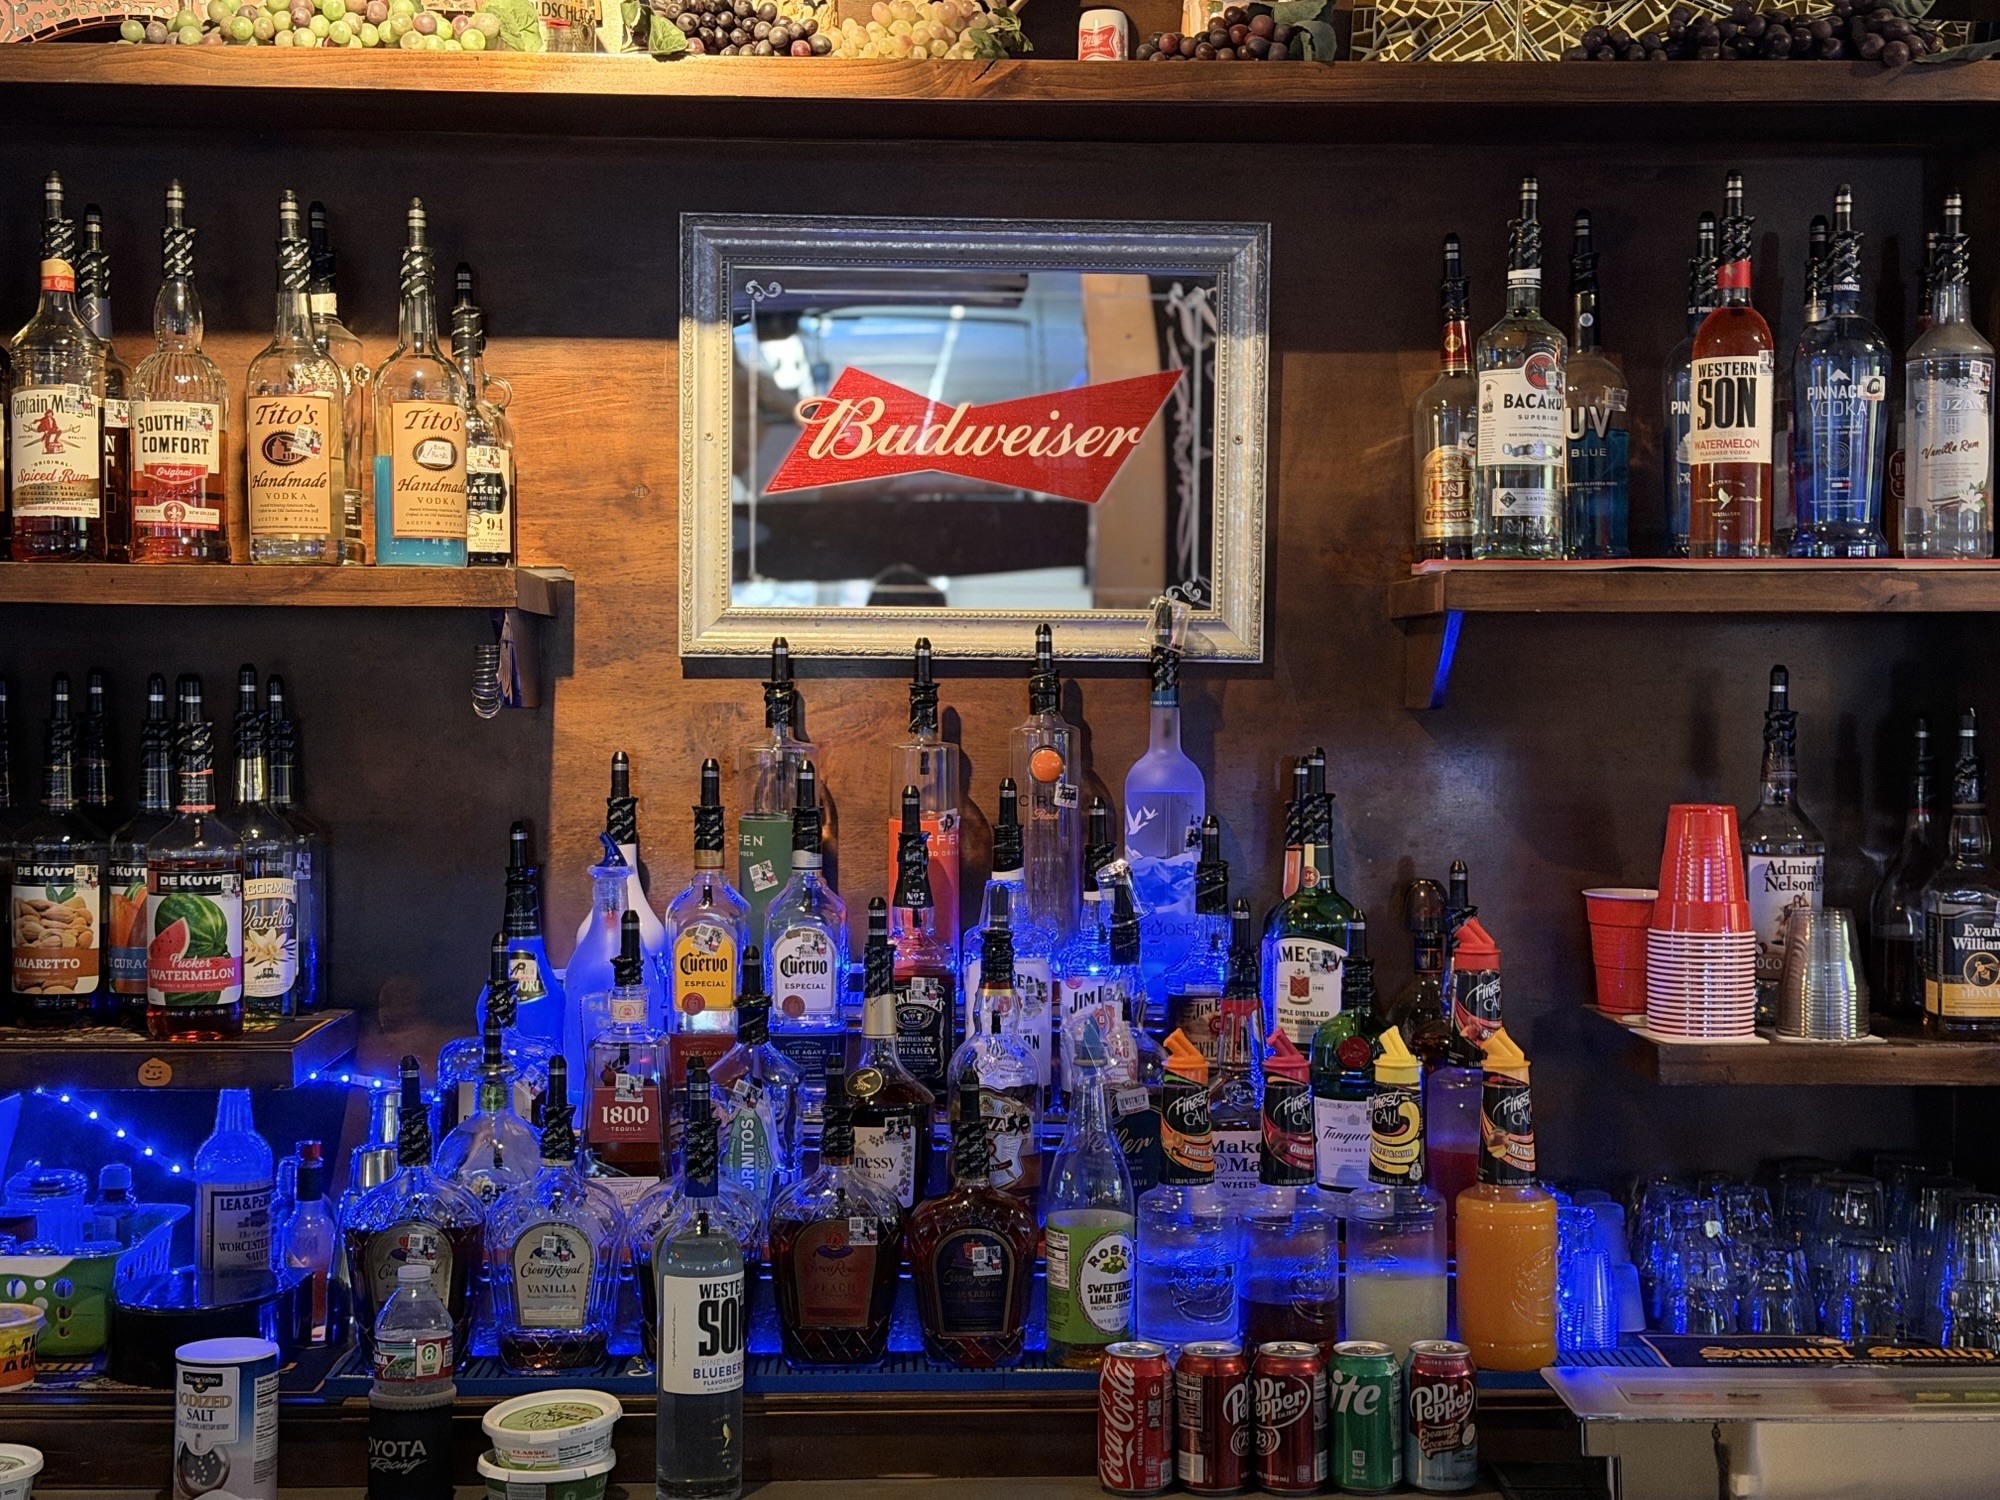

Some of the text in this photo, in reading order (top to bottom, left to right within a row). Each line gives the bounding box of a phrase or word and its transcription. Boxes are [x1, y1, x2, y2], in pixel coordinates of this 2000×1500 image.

[1698, 362, 1758, 378] WESTERN
[12, 395, 48, 418] Captain
[1503, 393, 1564, 411] BACARD
[1697, 377, 1758, 430] SON
[1810, 400, 1868, 417] VODKA
[138, 414, 189, 434] SOUTH
[1517, 414, 1559, 422] SUPERIOR
[1566, 406, 1612, 440] UV
[795, 396, 1141, 460] Budweiser
[142, 436, 208, 455] COMFORT
[1694, 438, 1760, 449] WATERMELON
[1922, 439, 1980, 460] Vanilla Rum
[1571, 448, 1607, 458] BLUE
[33, 459, 69, 467] ORIGINAL
[17, 468, 90, 484] Spiced Rum
[156, 466, 193, 478] Original
[252, 470, 327, 489] Handmade
[473, 477, 486, 486] The
[1437, 479, 1466, 499] E&J
[265, 492, 308, 501] VODKA
[467, 486, 501, 495] RAKEN
[417, 497, 456, 506] VODKA
[1432, 509, 1468, 519] BRANDY
[486, 517, 504, 532] 94
[1031, 809, 1061, 822] Peach
[17, 865, 74, 877] DE KUYP
[160, 874, 222, 887] DE KUYP
[244, 902, 294, 929] Vanilla
[13, 958, 80, 969] AMARETTO
[170, 953, 212, 968] Pucker
[679, 951, 728, 975] Cuervo
[779, 955, 828, 978] Cuervo
[150, 967, 235, 981] WATERMELON
[684, 980, 726, 988] ESPECIAL
[1466, 978, 1500, 1007] Fines
[1069, 990, 1096, 1014] JIM
[1193, 1002, 1212, 1020] JIM
[1295, 1009, 1330, 1018] DISTILLED
[899, 1047, 936, 1055] HISKEY
[602, 1105, 649, 1124] 1800
[1374, 1109, 1397, 1126] CALL
[741, 1118, 755, 1191] ORNITOS
[855, 1157, 898, 1174] nessy
[221, 1198, 241, 1211] LEA
[520, 1262, 583, 1278] Crown Royal
[527, 1284, 577, 1293] VANILLA
[1087, 1279, 1132, 1294] SWEETENE
[1090, 1293, 1132, 1305] LIME JUIC
[1700, 1345, 1854, 1359] Samuel
[702, 1358, 725, 1367] PINEY
[1444, 1359, 1465, 1367] EDITION
[703, 1377, 733, 1387] FLAVORED
[1260, 1378, 1286, 1399] Dr
[1330, 1370, 1381, 1415] ite
[1433, 1383, 1458, 1402] Dr
[178, 1395, 233, 1408] IODIZED
[1256, 1388, 1304, 1423] epper
[1411, 1387, 1471, 1424] Pepper
[186, 1409, 215, 1421] SALT
[1099, 1356, 1135, 1488] Coca-Cola
[1420, 1424, 1460, 1439] Creamy
[369, 1440, 427, 1458] YOTA
[370, 1458, 427, 1475] Racing
